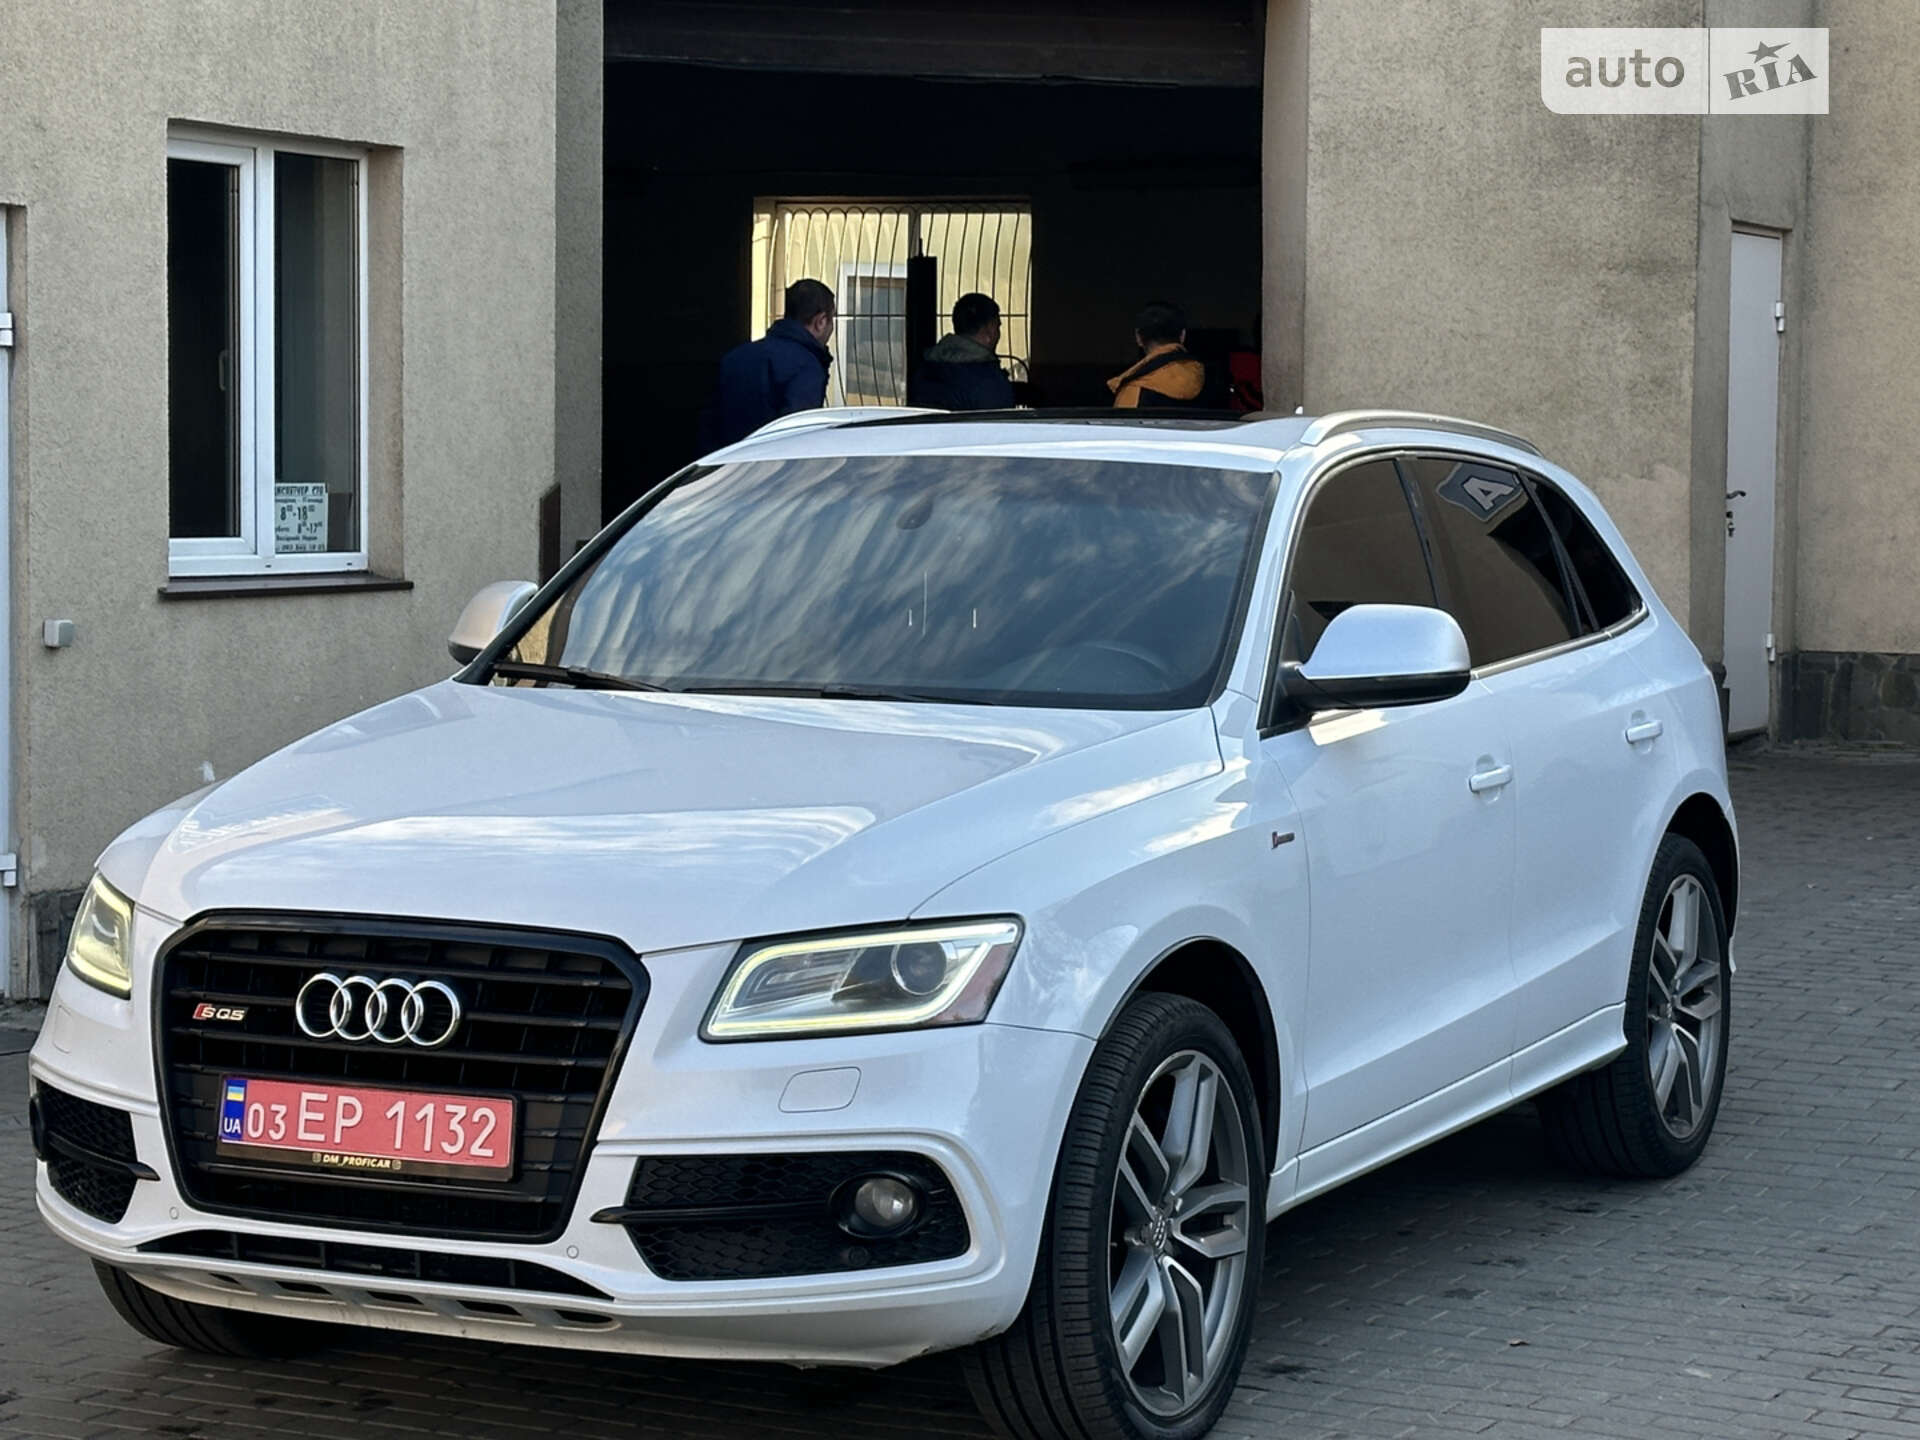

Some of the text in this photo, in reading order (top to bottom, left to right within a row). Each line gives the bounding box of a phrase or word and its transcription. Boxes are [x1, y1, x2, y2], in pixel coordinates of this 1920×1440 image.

[223, 1116, 242, 1134] UA
[247, 1091, 498, 1158] 03 EP 1132
